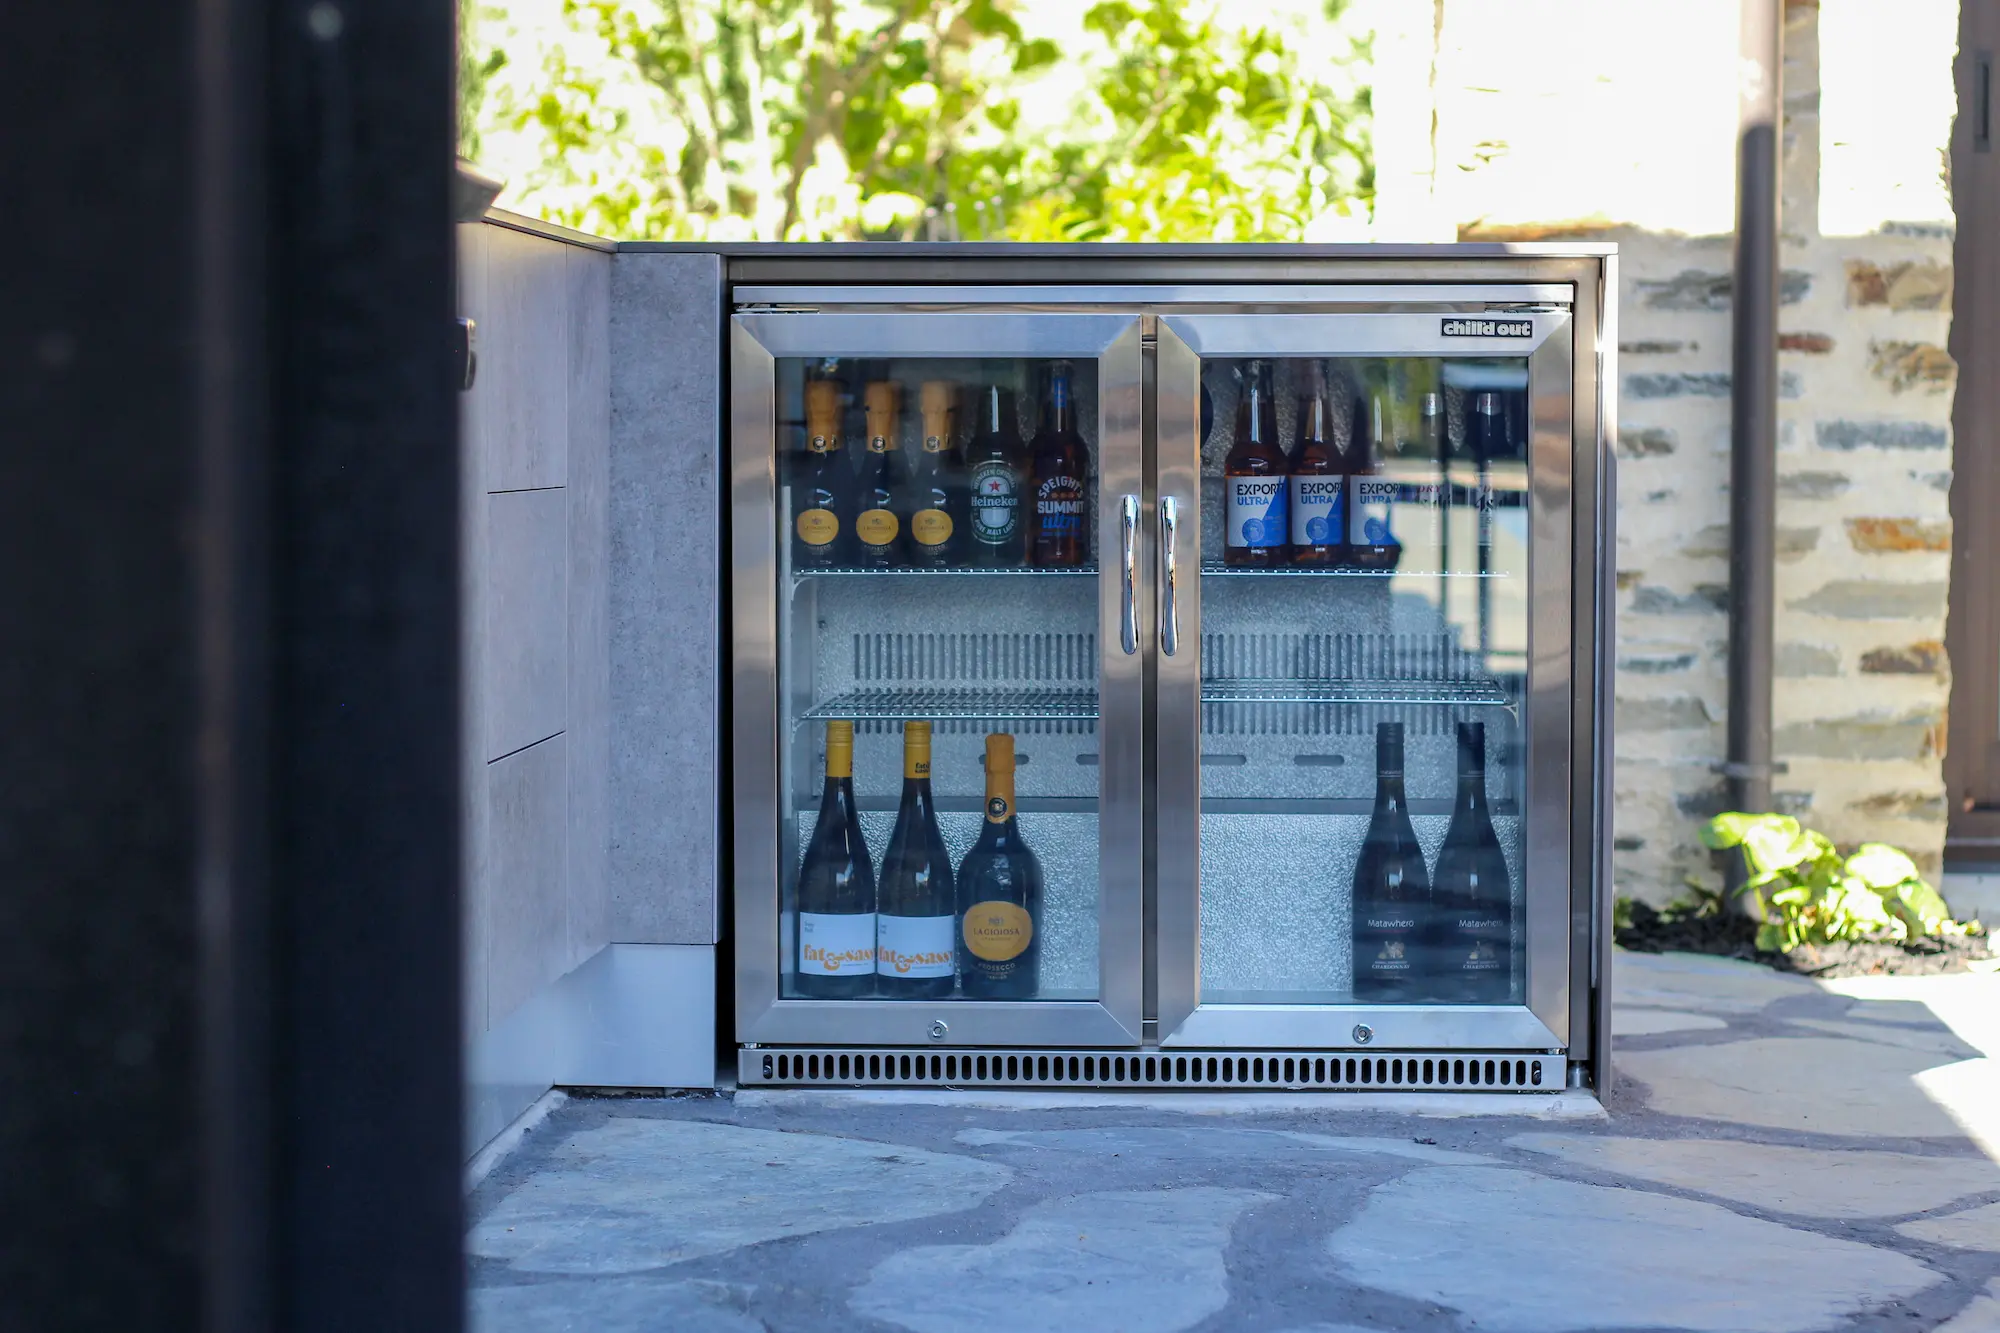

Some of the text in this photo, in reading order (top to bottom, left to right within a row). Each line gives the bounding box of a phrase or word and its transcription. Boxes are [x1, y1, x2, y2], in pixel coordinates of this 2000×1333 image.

[1497, 322, 1531, 336] out
[971, 496, 1018, 507] Heineken
[1237, 496, 1270, 506] ULTRA
[1301, 495, 1333, 505] ULTRA
[1360, 495, 1392, 505] ULTRA
[1037, 500, 1084, 514] SUMMIT
[1367, 919, 1415, 928] Matawhero
